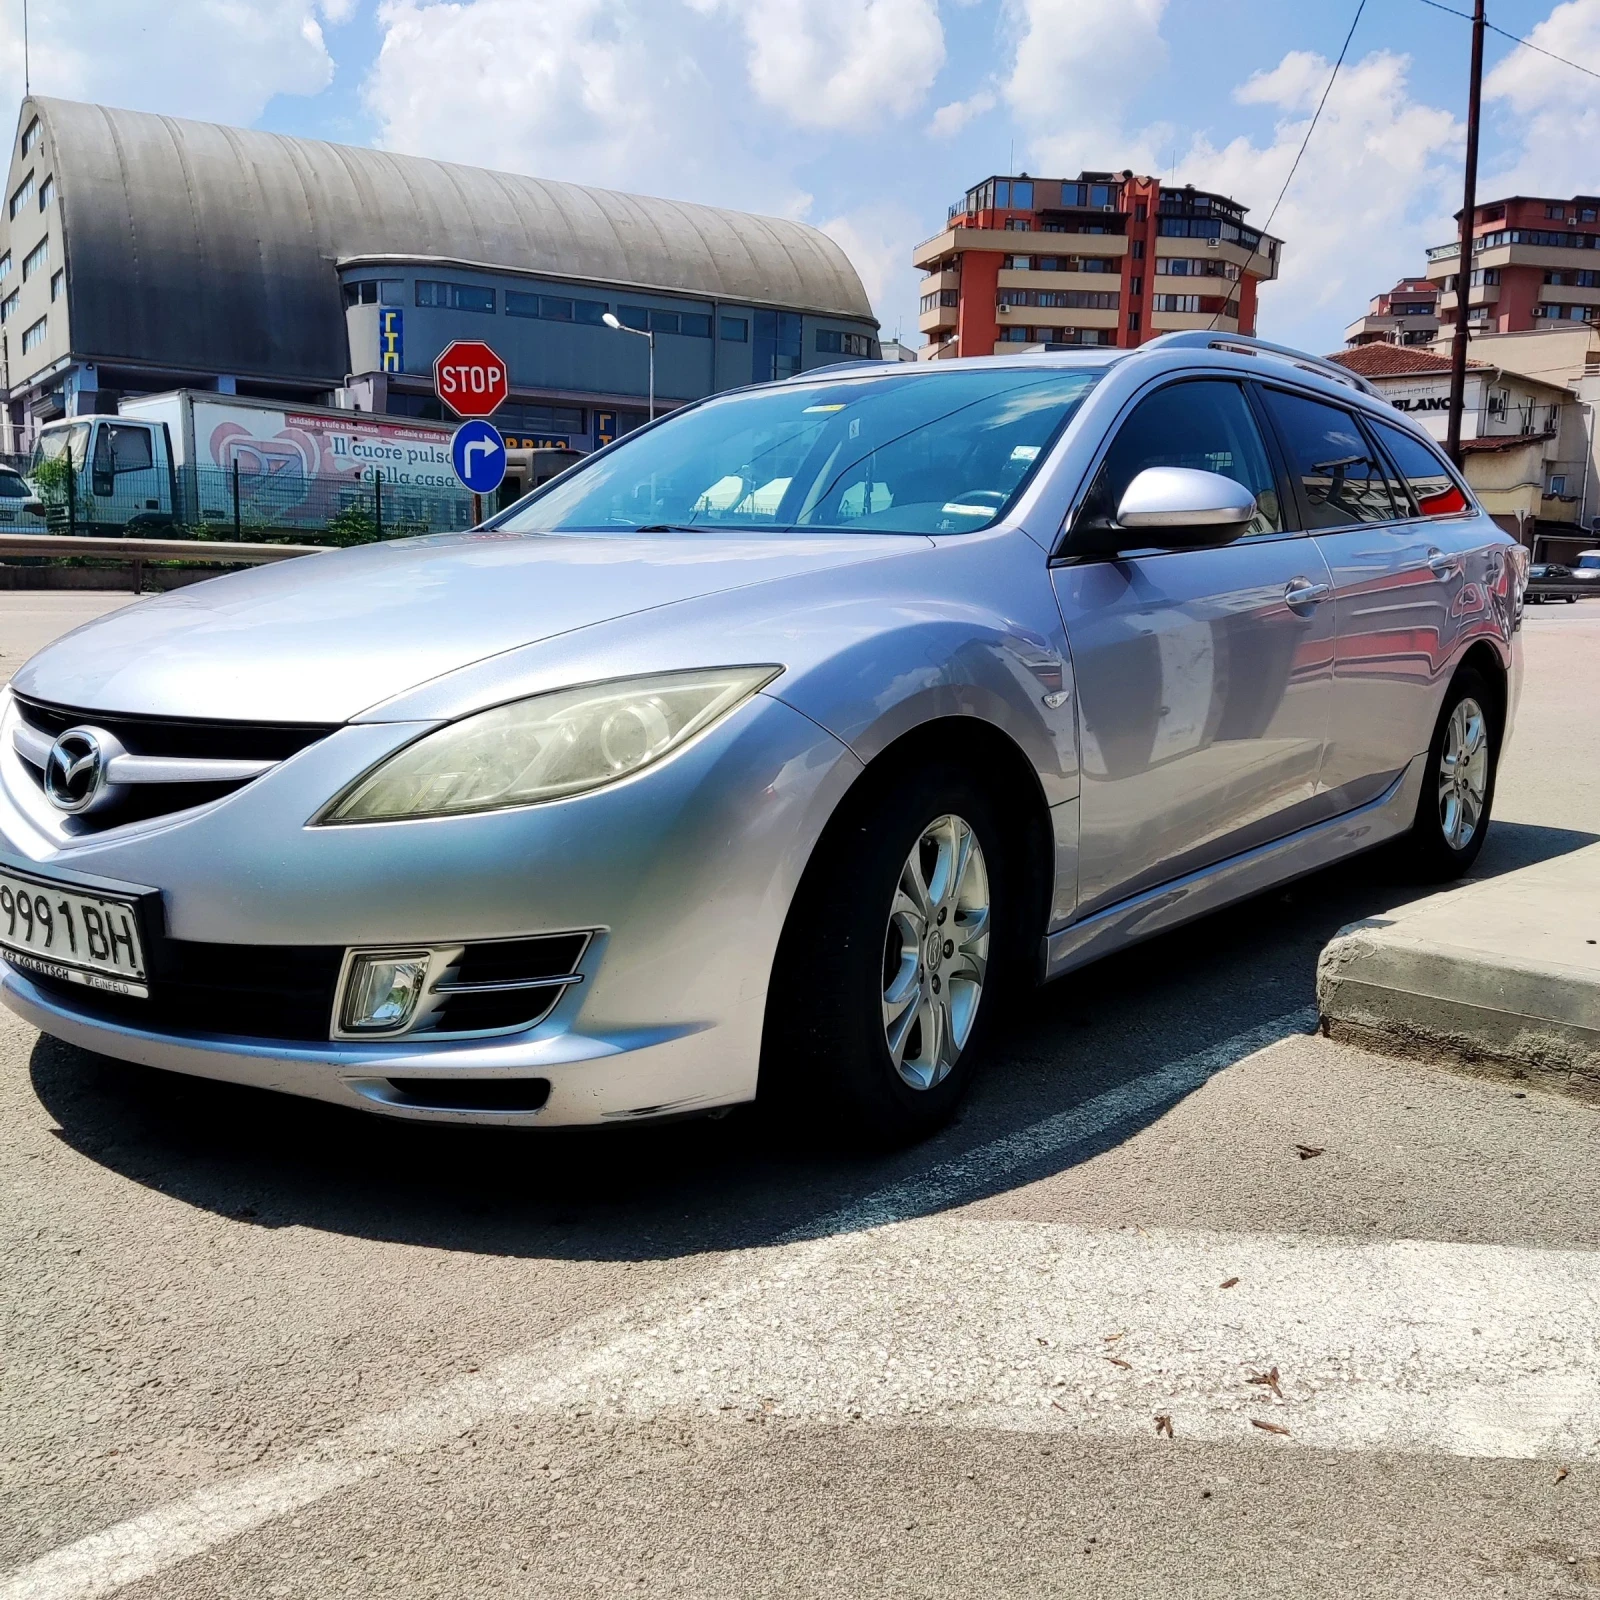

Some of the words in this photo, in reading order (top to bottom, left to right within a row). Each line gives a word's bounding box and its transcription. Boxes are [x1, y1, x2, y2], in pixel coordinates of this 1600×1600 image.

[384, 312, 399, 372] ГТП
[442, 366, 501, 393] STOP
[1391, 397, 1465, 412] BLANC
[321, 420, 340, 430] stufe
[346, 423, 379, 434] biomasse
[424, 431, 441, 441] stufe
[333, 436, 347, 455] Il
[352, 444, 403, 460] cuore
[363, 464, 410, 484] della
[414, 473, 456, 488] casa
